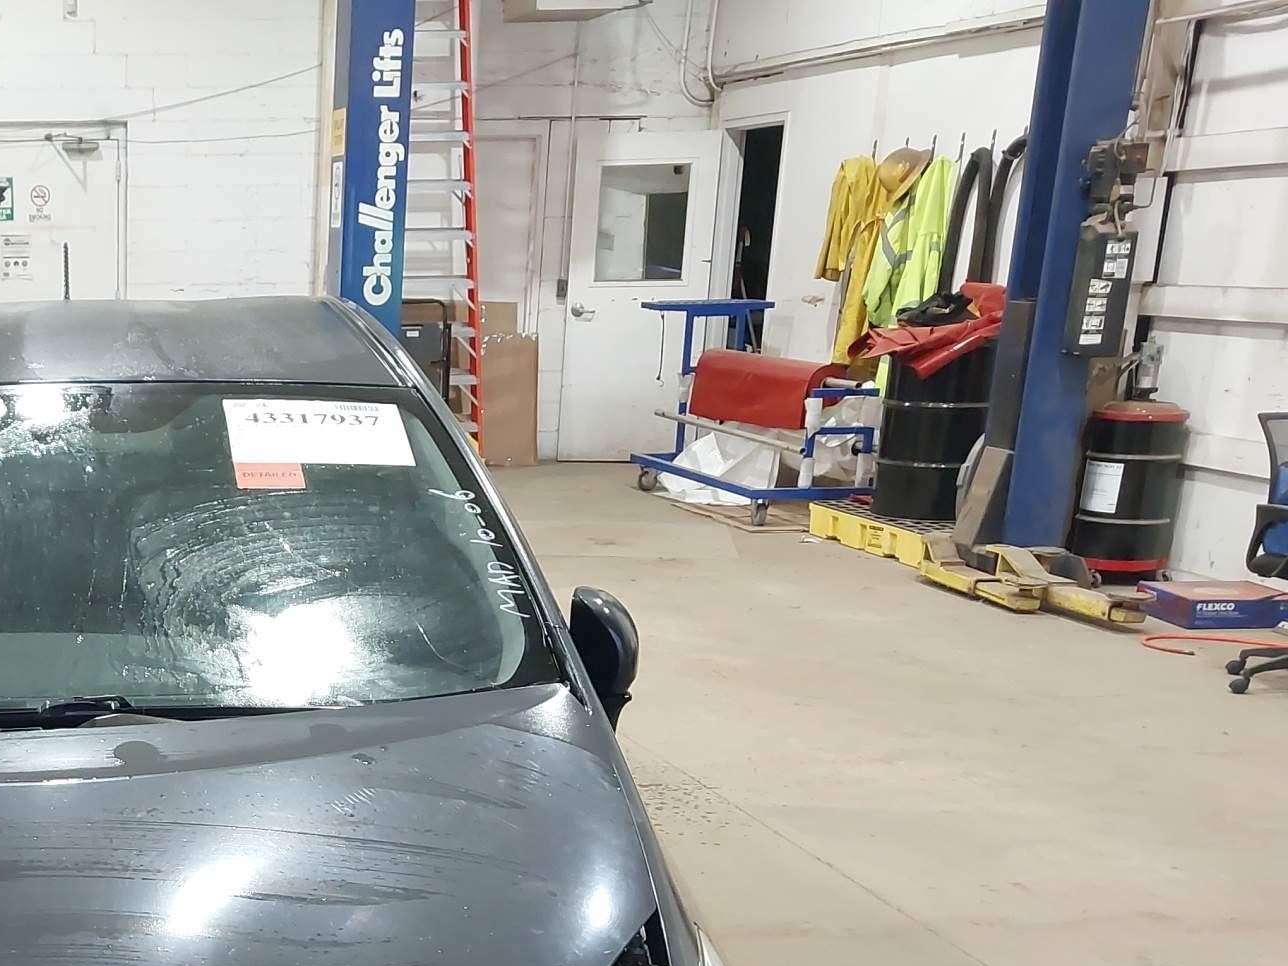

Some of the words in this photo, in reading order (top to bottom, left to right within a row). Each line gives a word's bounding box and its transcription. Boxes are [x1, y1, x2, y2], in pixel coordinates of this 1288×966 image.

[372, 28, 405, 99] Lifts
[358, 105, 405, 306] Challenger
[244, 411, 380, 427] 43317937
[1196, 602, 1235, 611] FLEXCO
